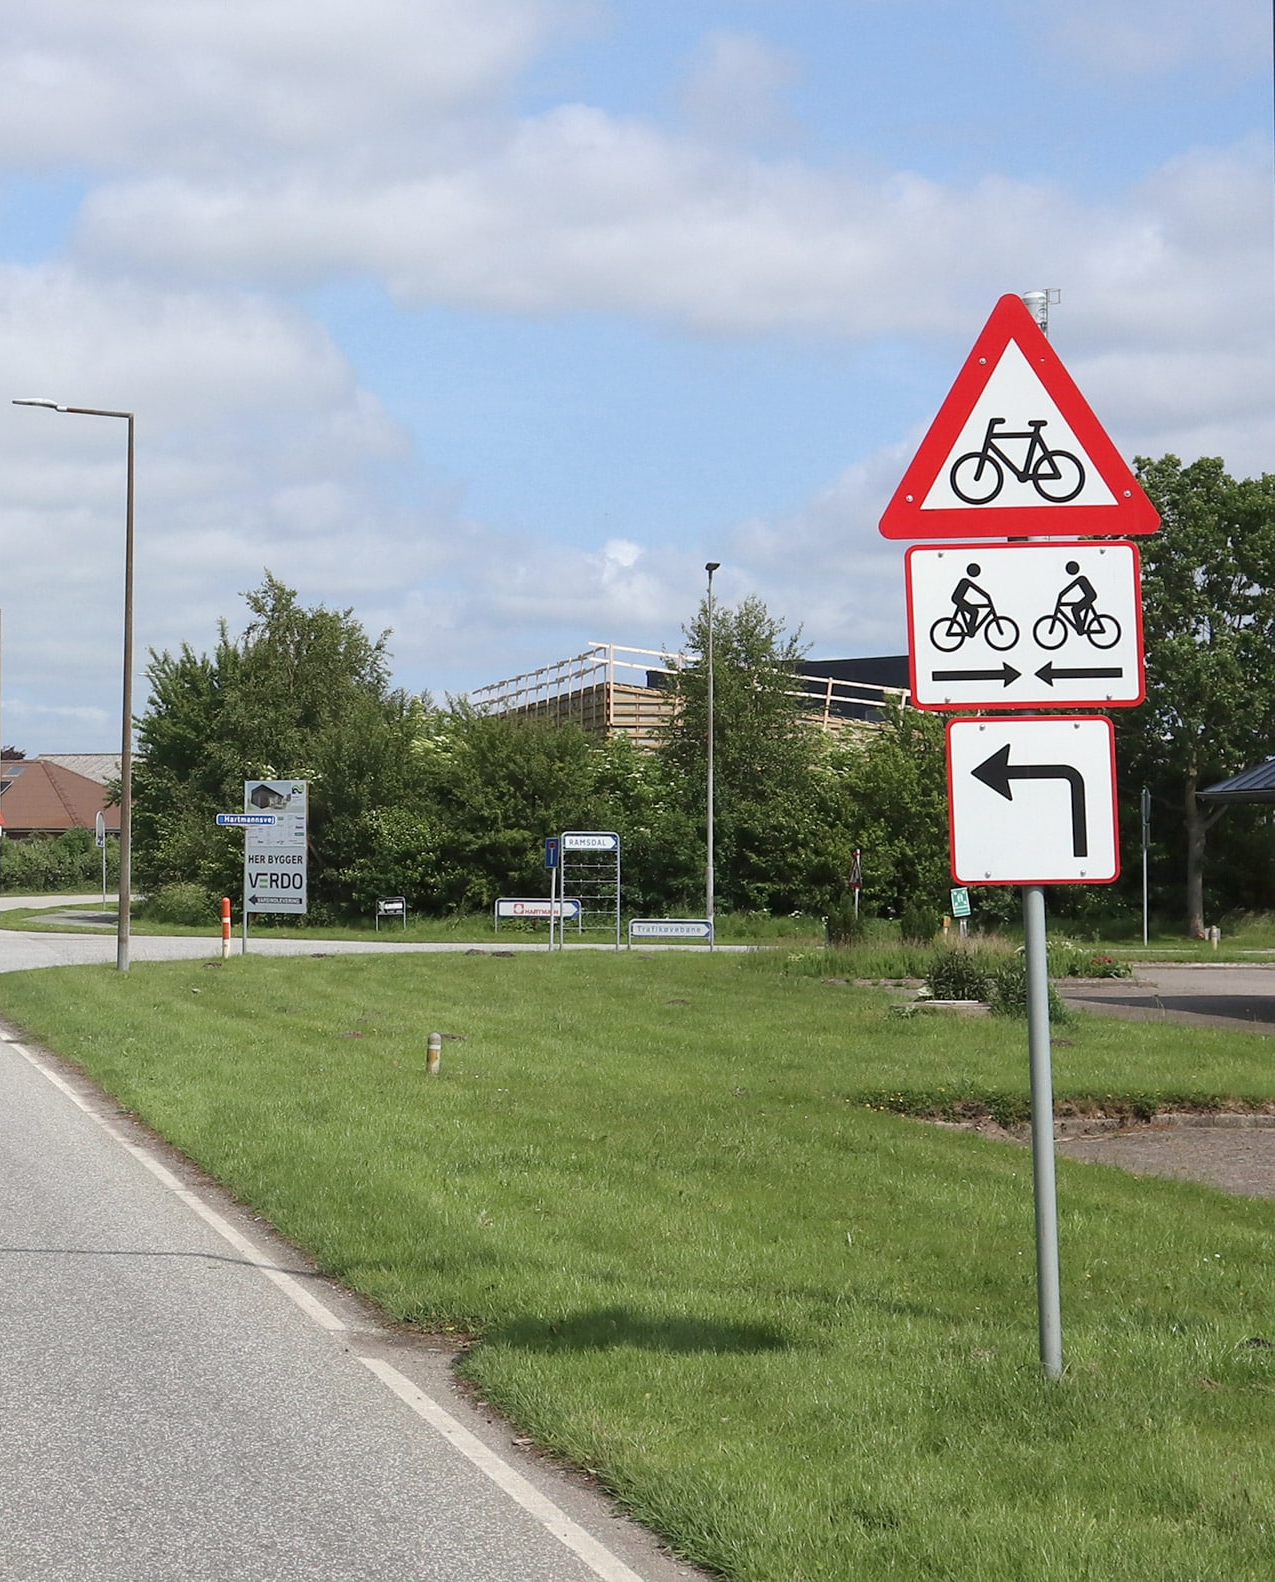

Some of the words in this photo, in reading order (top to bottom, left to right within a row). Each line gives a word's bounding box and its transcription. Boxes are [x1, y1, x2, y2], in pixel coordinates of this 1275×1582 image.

[224, 815, 275, 824] Hartmannsvej
[568, 839, 606, 847] RAMSDAL
[248, 855, 266, 864] HER
[268, 855, 303, 864] BYGGER
[248, 872, 303, 890] VERDO
[636, 925, 701, 933] Trafikøvebane
